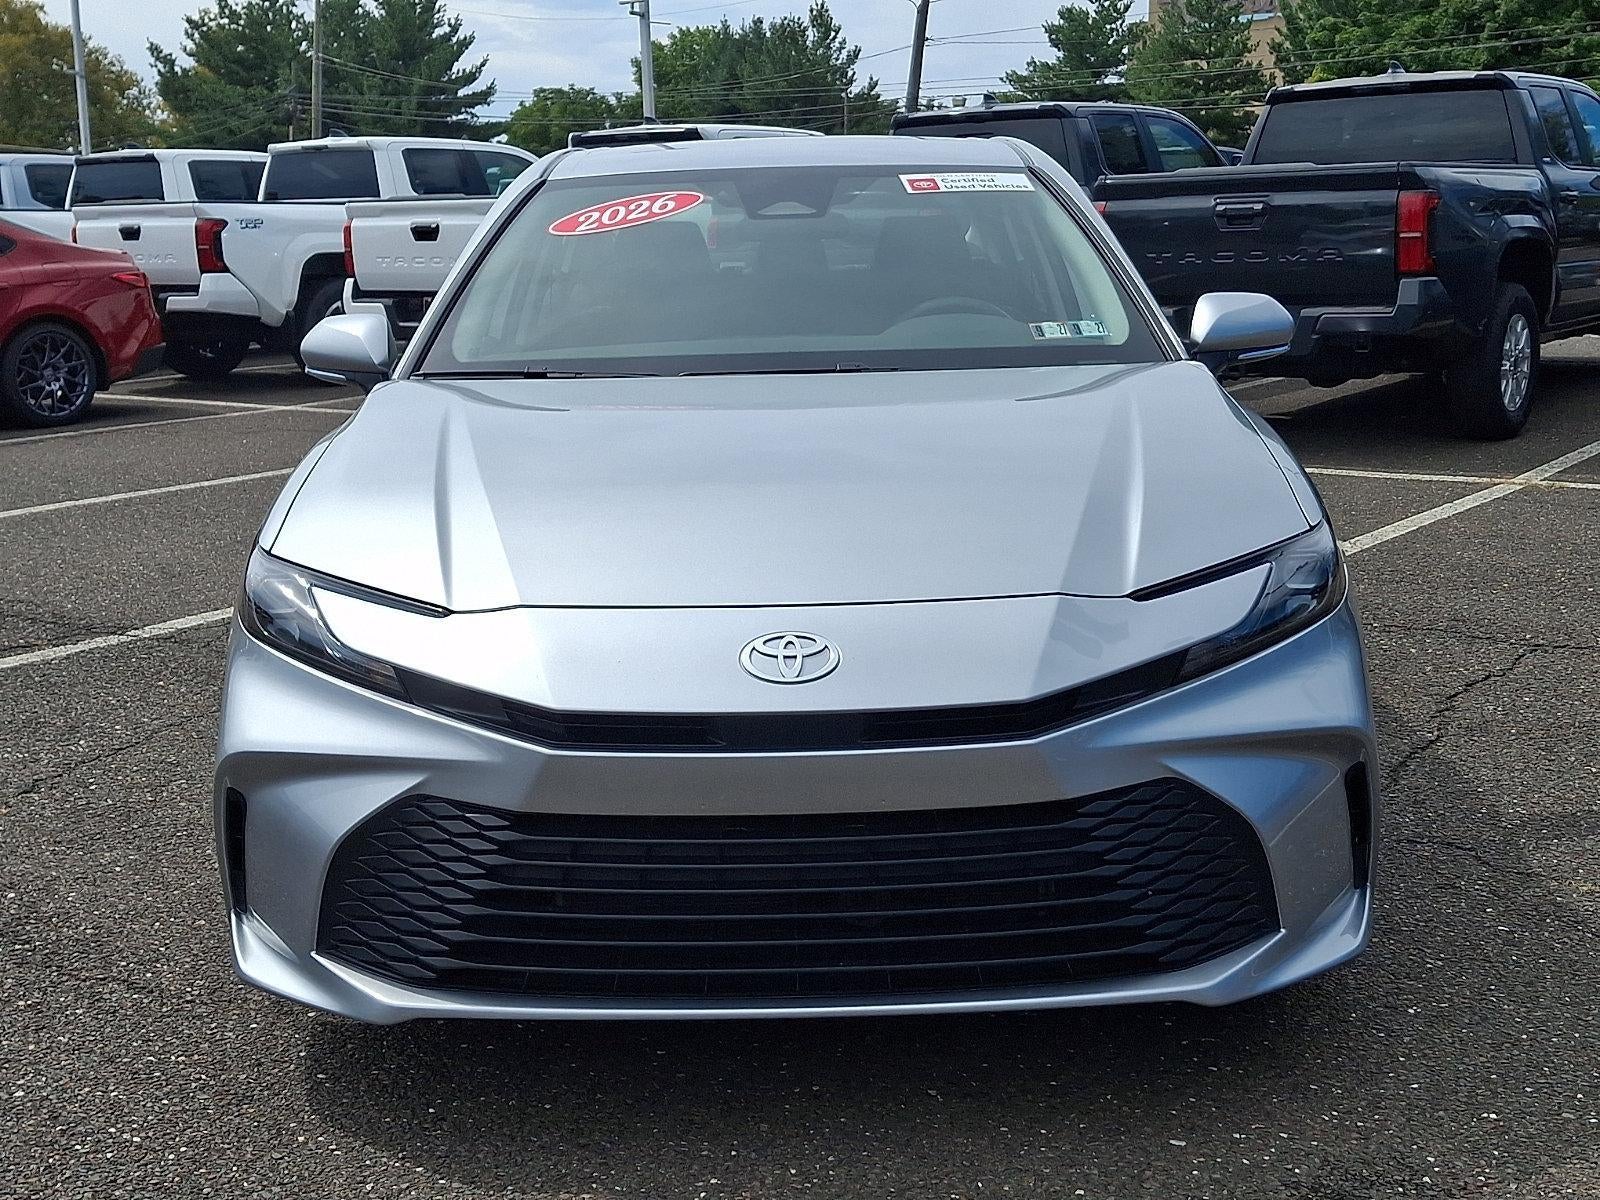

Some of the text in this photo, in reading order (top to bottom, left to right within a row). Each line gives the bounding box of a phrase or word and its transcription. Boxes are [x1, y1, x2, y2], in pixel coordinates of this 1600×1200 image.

[575, 193, 678, 233] 2026
[134, 253, 177, 263] OMA
[375, 256, 455, 267] TACO
[1146, 247, 1344, 264] TACOMA
[1057, 323, 1068, 336] 27
[1095, 321, 1106, 334] 27
